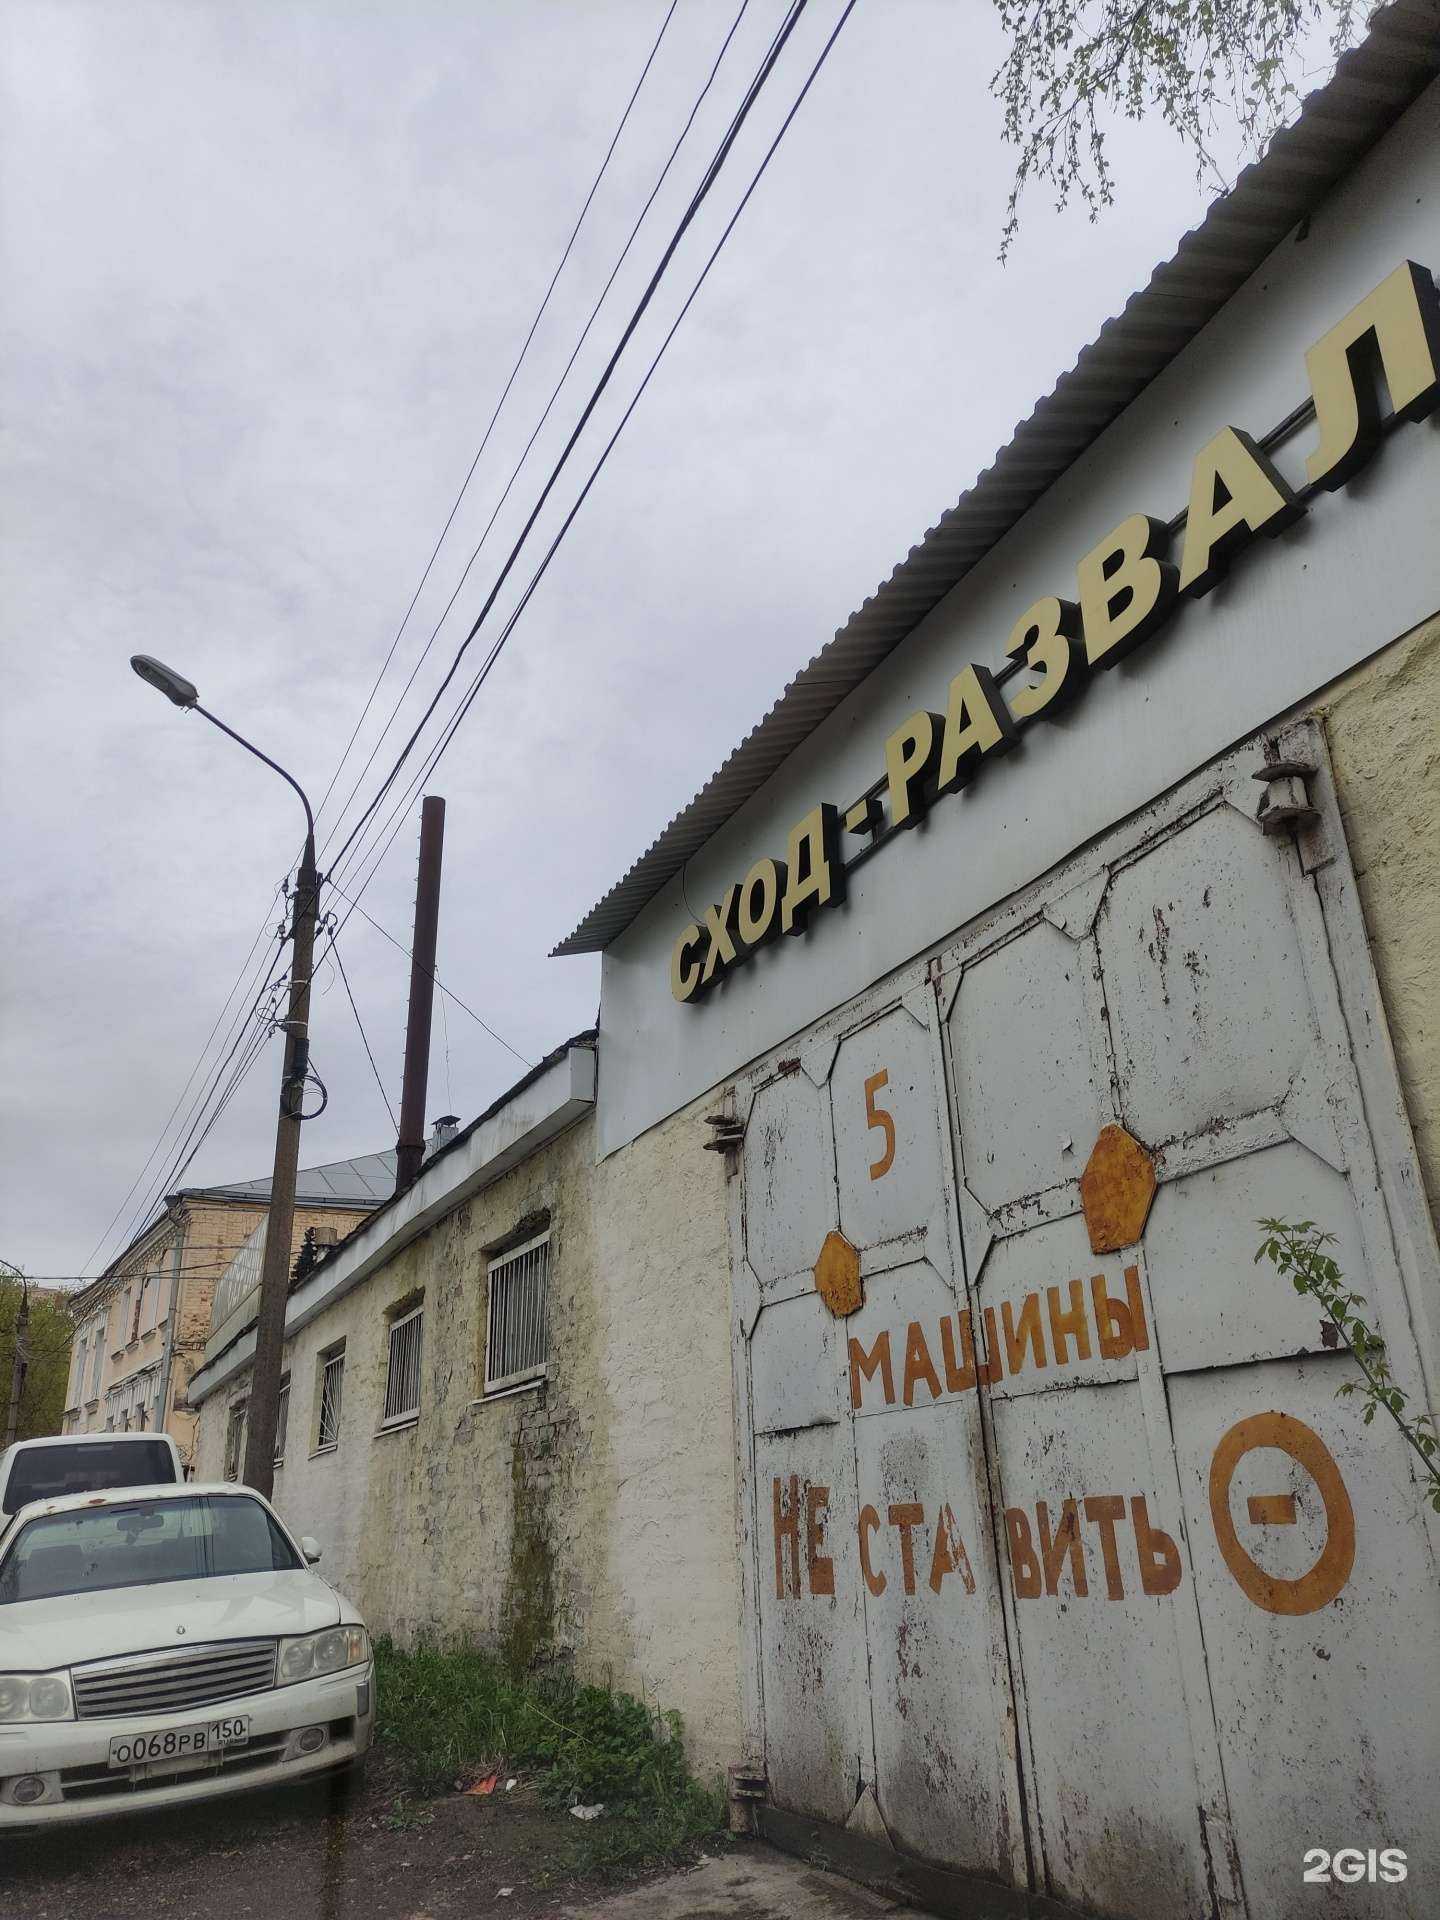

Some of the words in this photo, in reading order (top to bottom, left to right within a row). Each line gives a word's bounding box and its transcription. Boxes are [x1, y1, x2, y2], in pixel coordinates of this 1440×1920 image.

[670, 259, 1439, 1003] СХОД-РАЗВАЛ
[865, 1069, 896, 1180] 5
[849, 1265, 1149, 1410] МАШИНЫ
[773, 1475, 835, 1600] НЕ
[858, 1494, 1182, 1601] СТАВИТЬ
